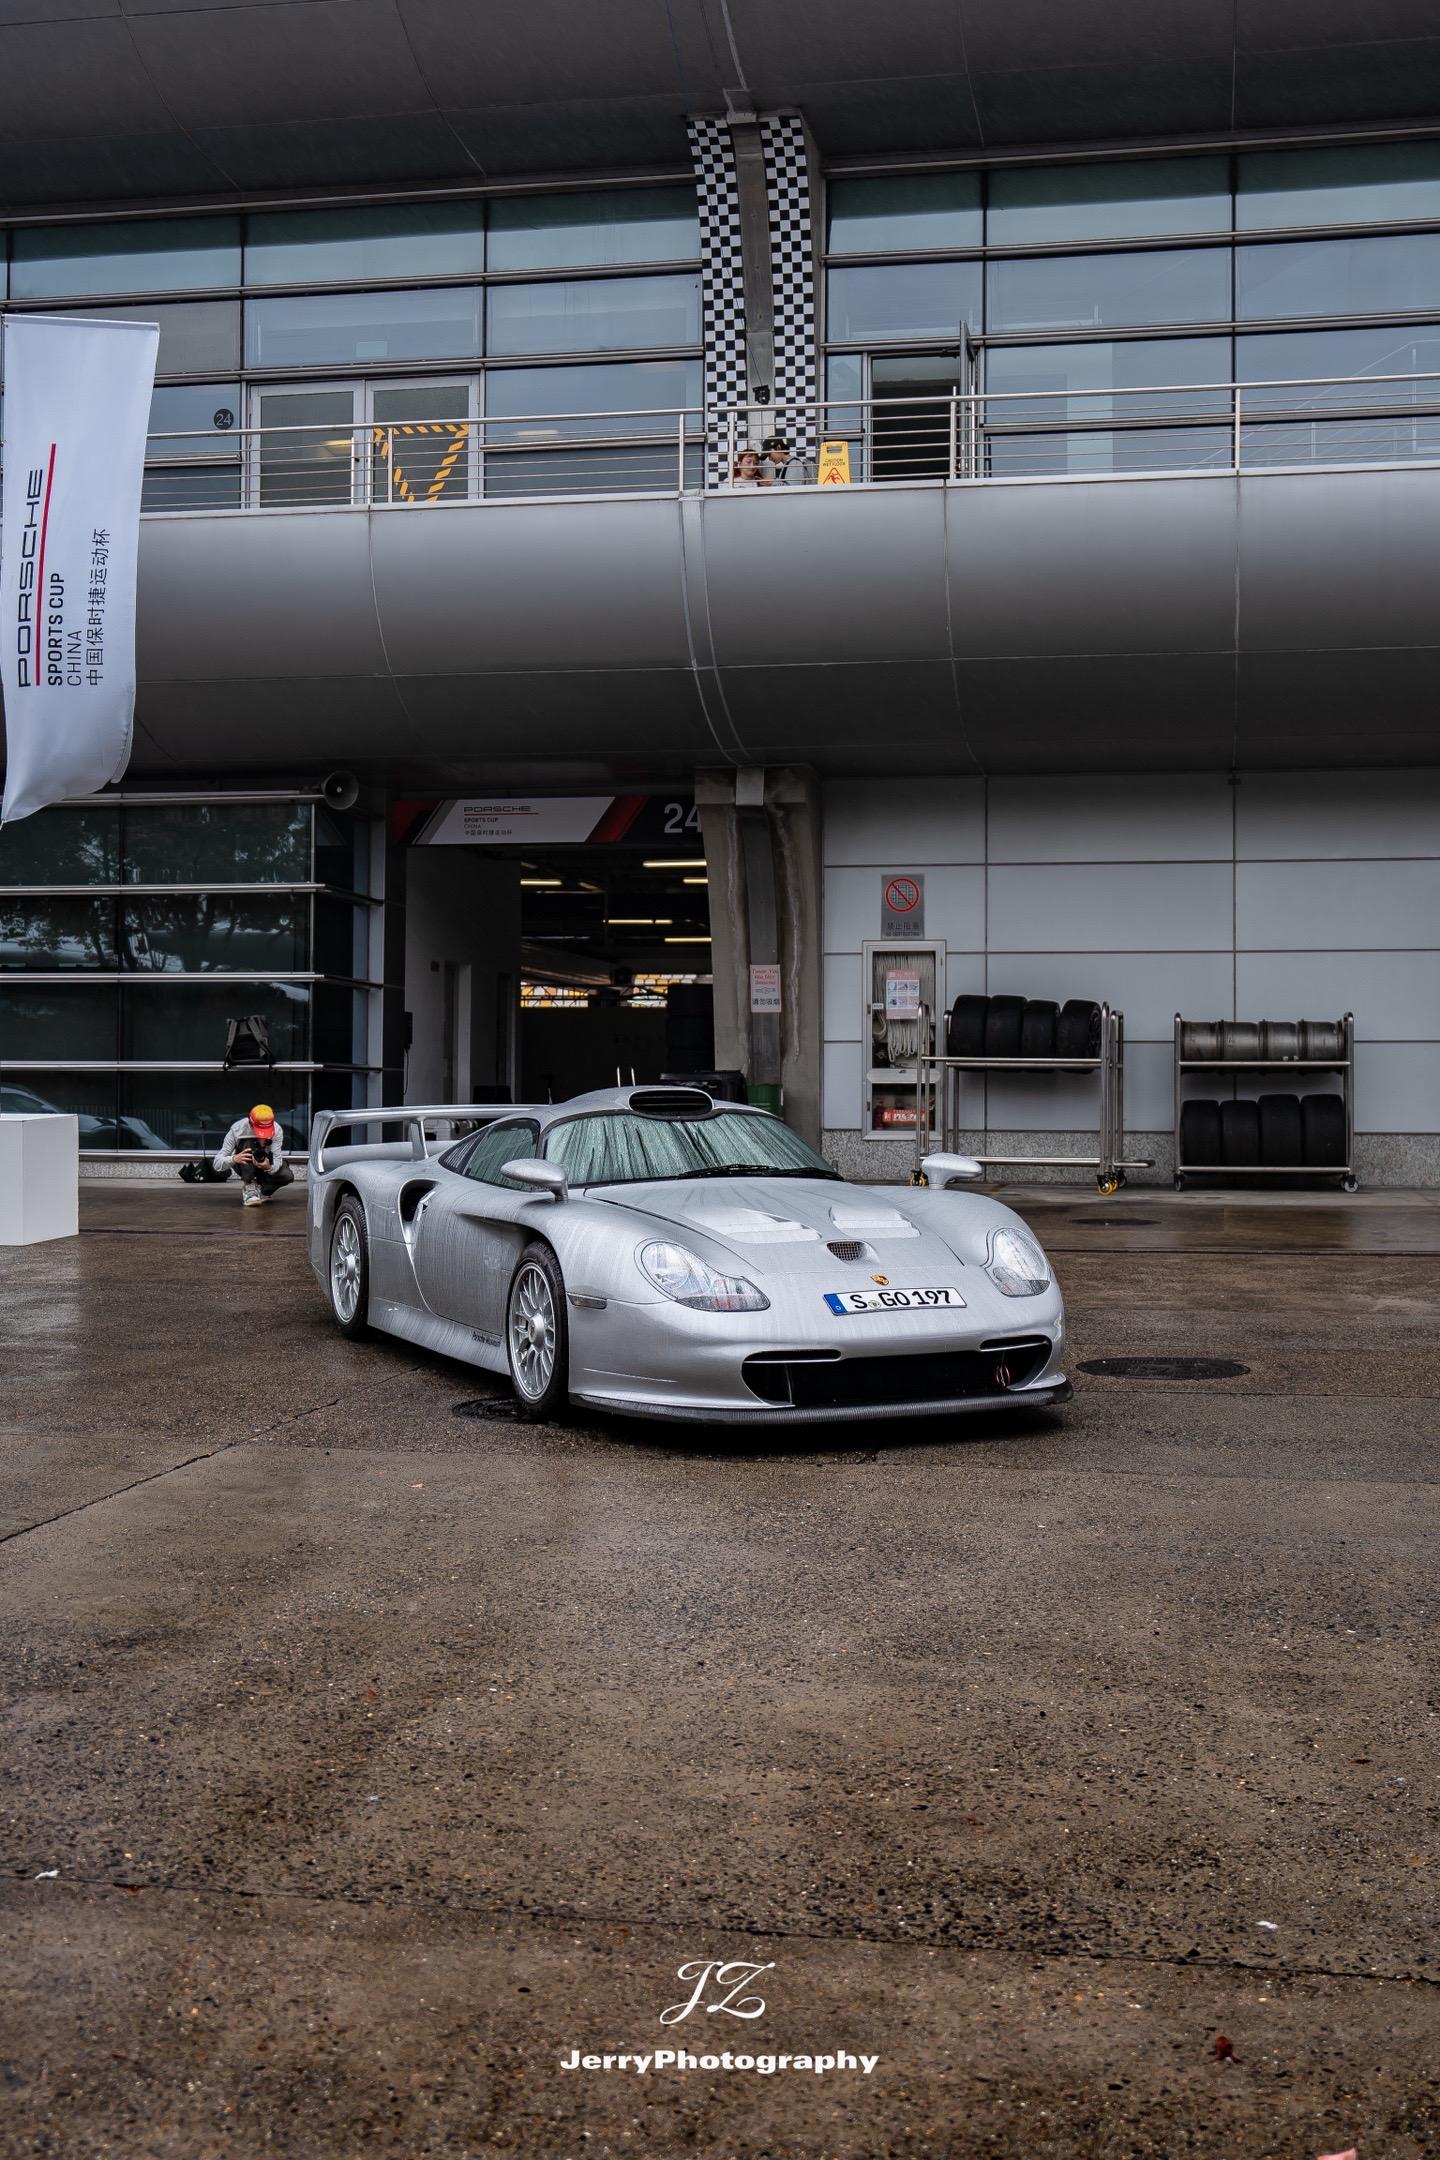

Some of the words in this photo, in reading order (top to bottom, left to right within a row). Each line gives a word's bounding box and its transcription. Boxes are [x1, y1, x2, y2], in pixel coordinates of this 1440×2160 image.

[216, 413, 232, 426] 24
[17, 469, 43, 688] PORSCHE
[49, 572, 65, 609] CUP
[86, 528, 111, 686] 中国保时捷运动杯
[47, 614, 63, 686] SPORTS
[66, 629, 82, 687] CHINA
[463, 805, 532, 813] PORSCHE
[664, 803, 702, 833] 24
[850, 1294, 868, 1309] S
